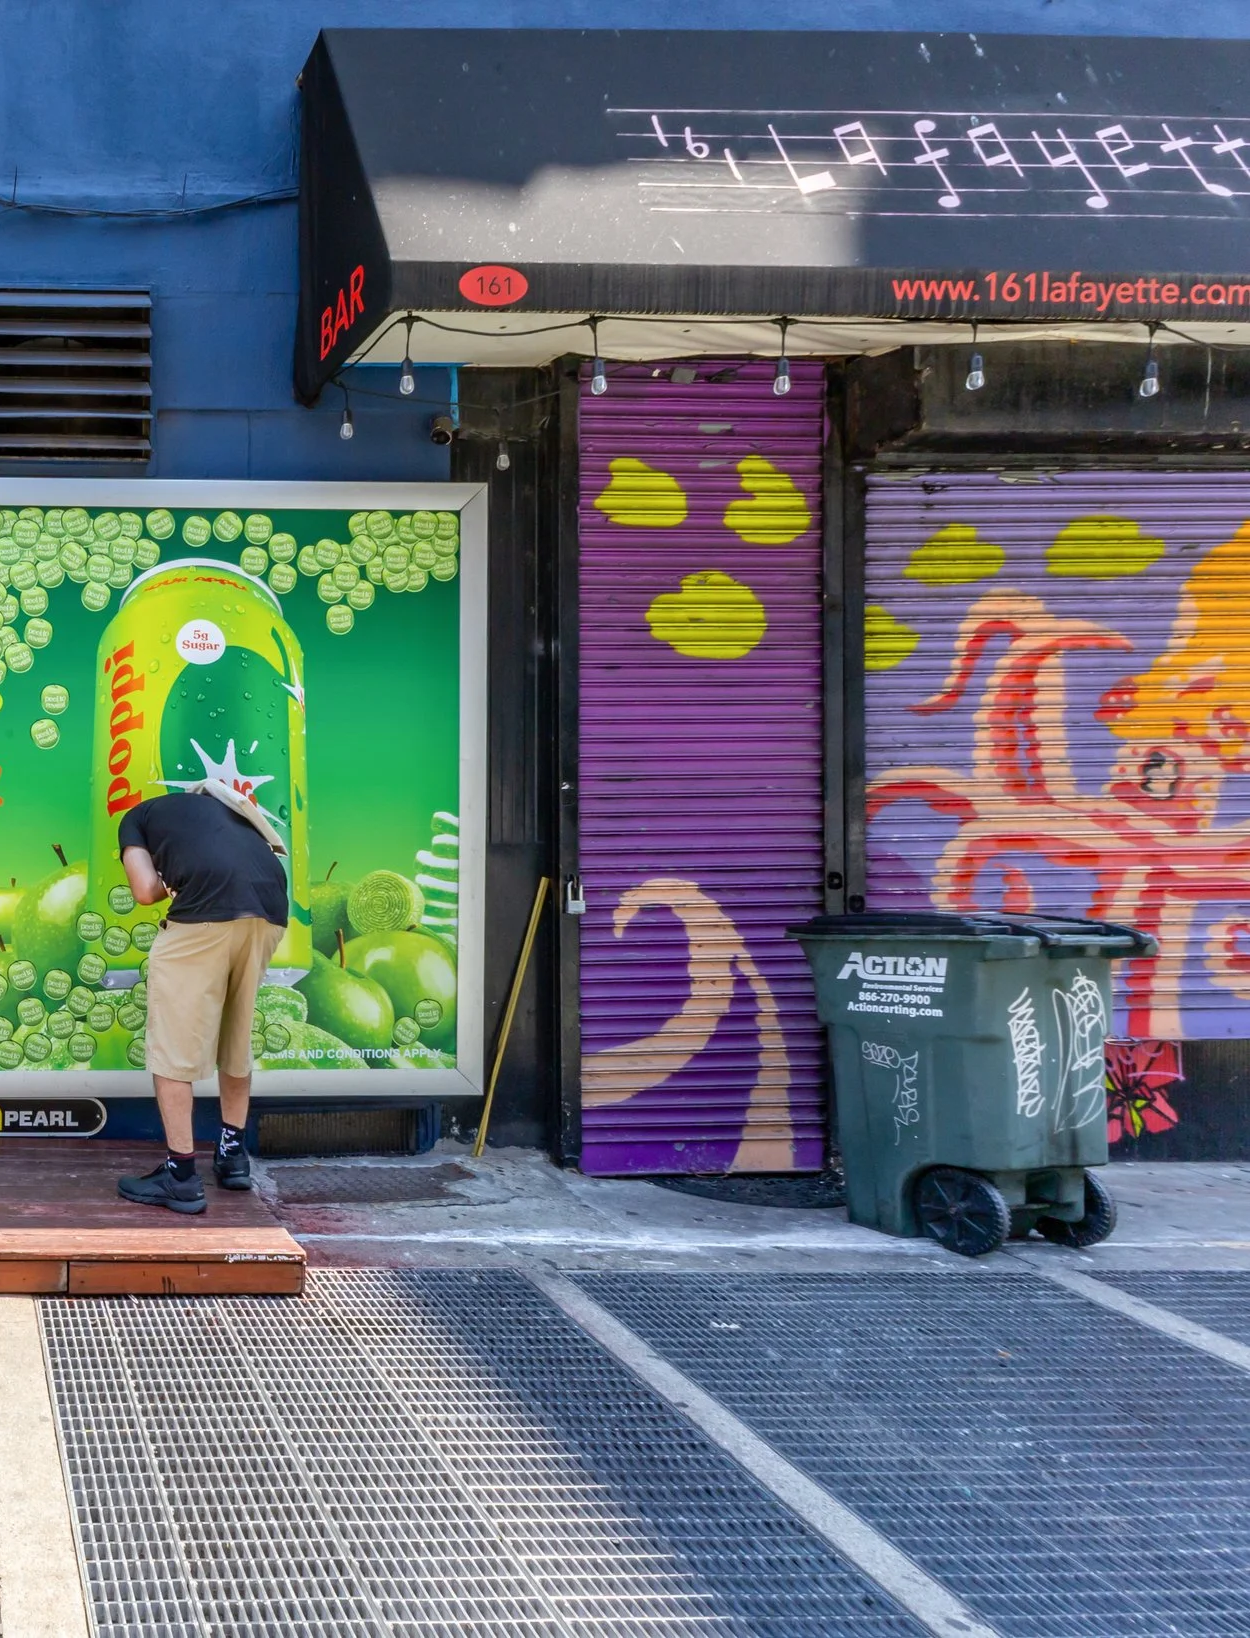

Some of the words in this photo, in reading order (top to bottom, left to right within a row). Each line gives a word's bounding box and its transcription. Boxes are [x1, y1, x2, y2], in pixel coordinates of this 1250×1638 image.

[476, 276, 512, 295] 161
[892, 271, 1250, 312] www.161lafayette.com
[320, 264, 365, 361] BAR
[193, 630, 208, 640] 5g
[182, 640, 220, 651] Sugar
[104, 640, 144, 817] poppi
[836, 952, 948, 984] ACTION
[862, 982, 912, 991] Environmental
[913, 984, 944, 992] Services
[858, 992, 930, 1005] 866-270-9900
[847, 1002, 943, 1018] Actioncarting.com
[262, 1050, 296, 1059] ERMS
[300, 1049, 324, 1059] AND
[327, 1048, 400, 1059] CONDITIONS
[404, 1048, 440, 1059] APPLY
[4, 1110, 78, 1127] PEARL
